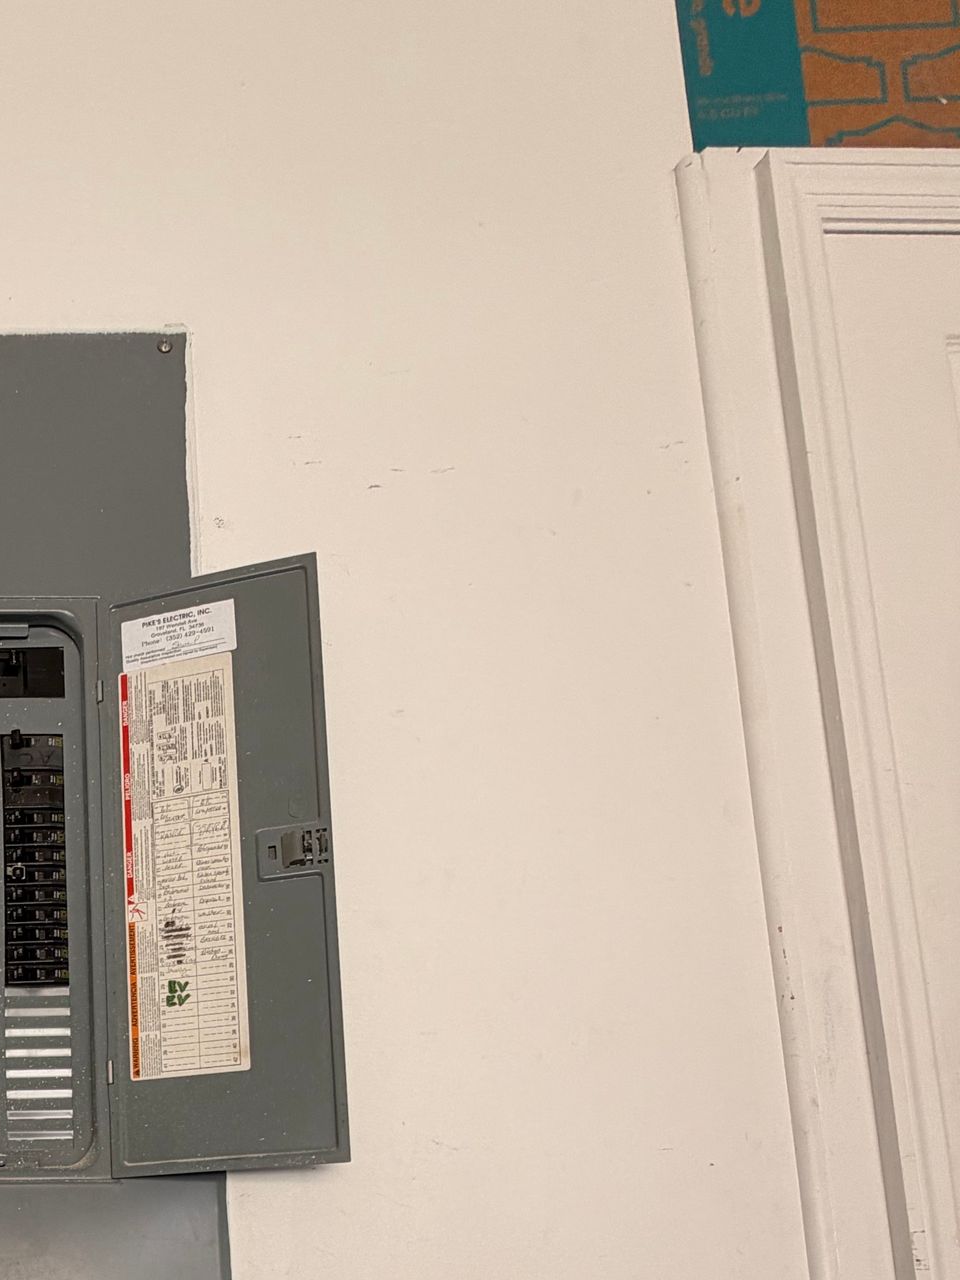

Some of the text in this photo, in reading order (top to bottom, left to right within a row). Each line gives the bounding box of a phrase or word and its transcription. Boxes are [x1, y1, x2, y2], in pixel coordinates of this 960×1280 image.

[141, 607, 213, 629] PIKE'S ELECTRIC, INC.
[166, 632, 183, 642] (352)
[168, 980, 190, 995] EV
[166, 993, 191, 1008] EV
